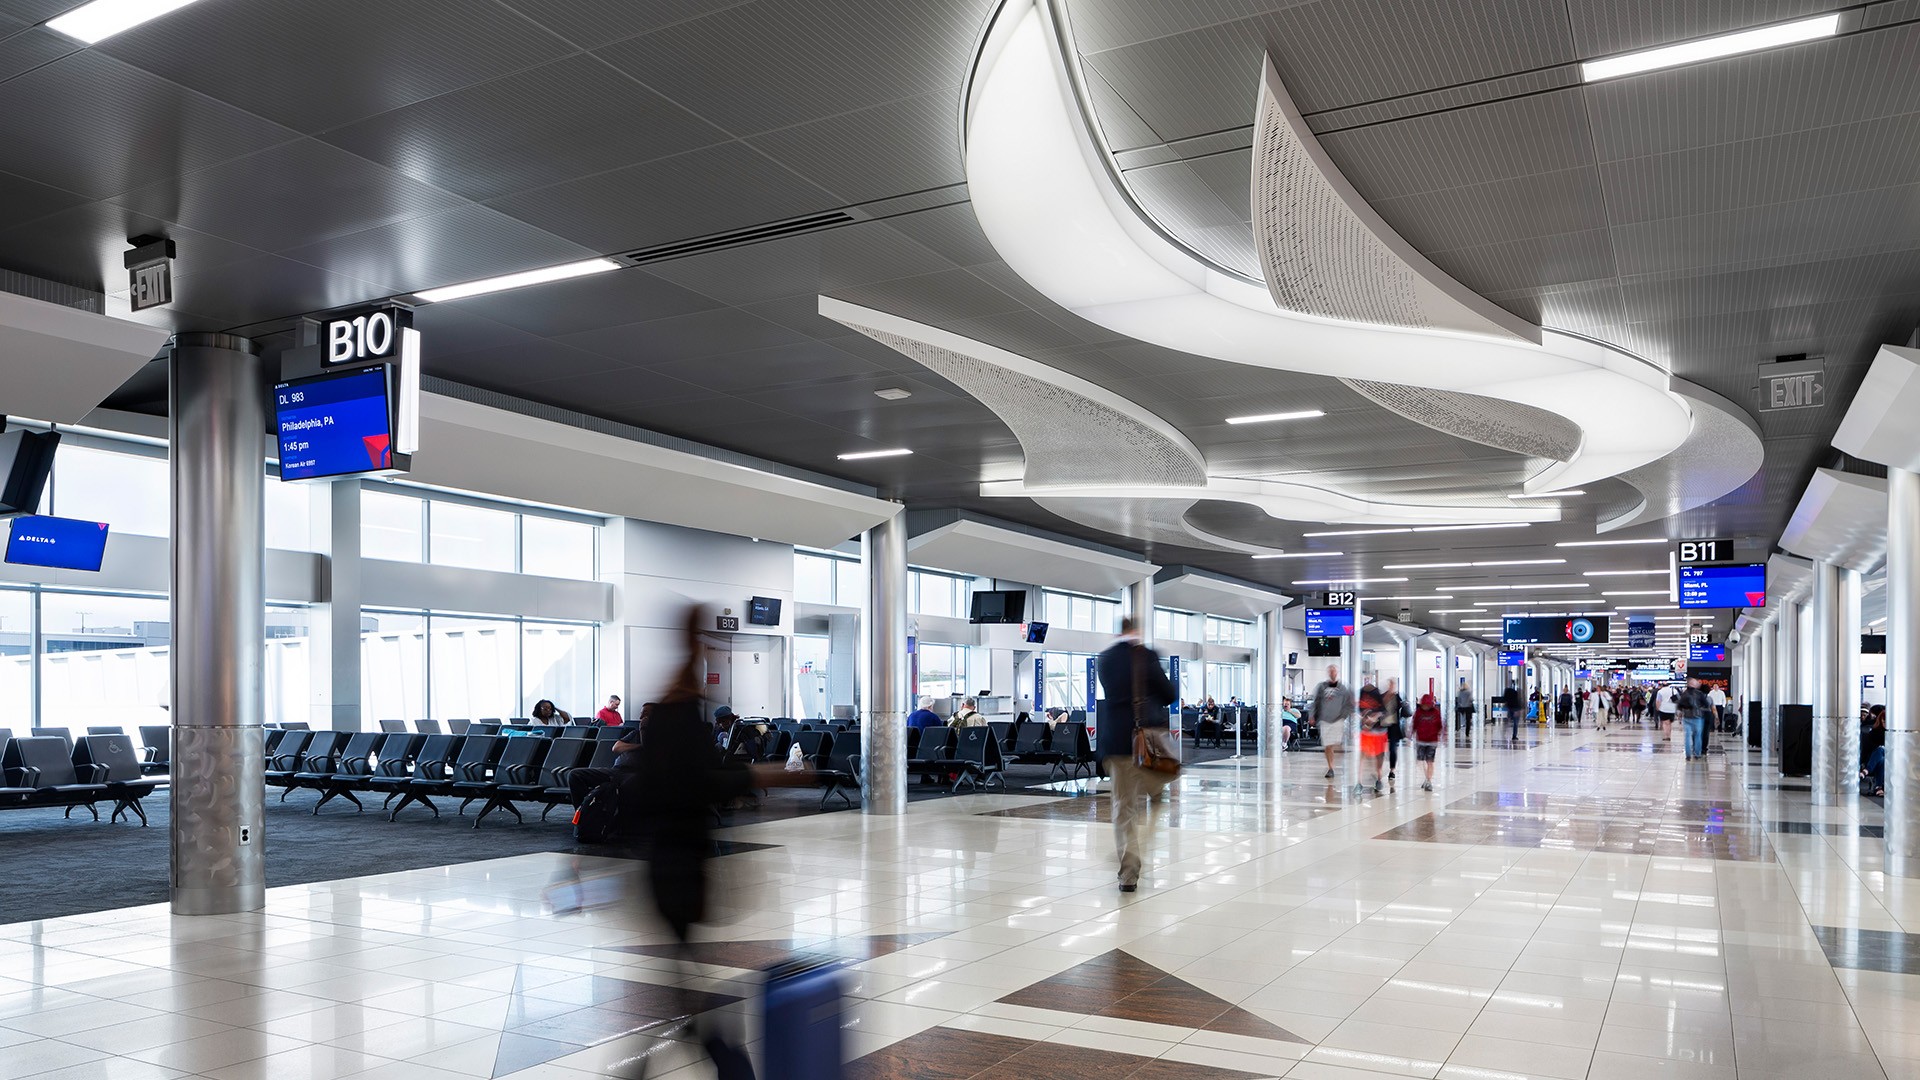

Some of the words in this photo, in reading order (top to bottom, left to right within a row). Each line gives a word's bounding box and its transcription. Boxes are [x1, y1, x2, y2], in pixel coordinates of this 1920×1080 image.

[136, 263, 167, 308] EXIT
[329, 312, 392, 363] B10
[279, 395, 289, 405] DL
[291, 391, 305, 403] 983
[1771, 375, 1815, 408] EXIT
[281, 420, 323, 432] Philadelphia,
[323, 416, 334, 426] PA
[284, 441, 298, 451] 1:45
[298, 442, 309, 452] pm
[26, 535, 49, 544] DELTA
[1680, 541, 1715, 562] B11
[1328, 592, 1354, 605] B12
[722, 618, 735, 629] B12
[1690, 634, 1708, 643] B13
